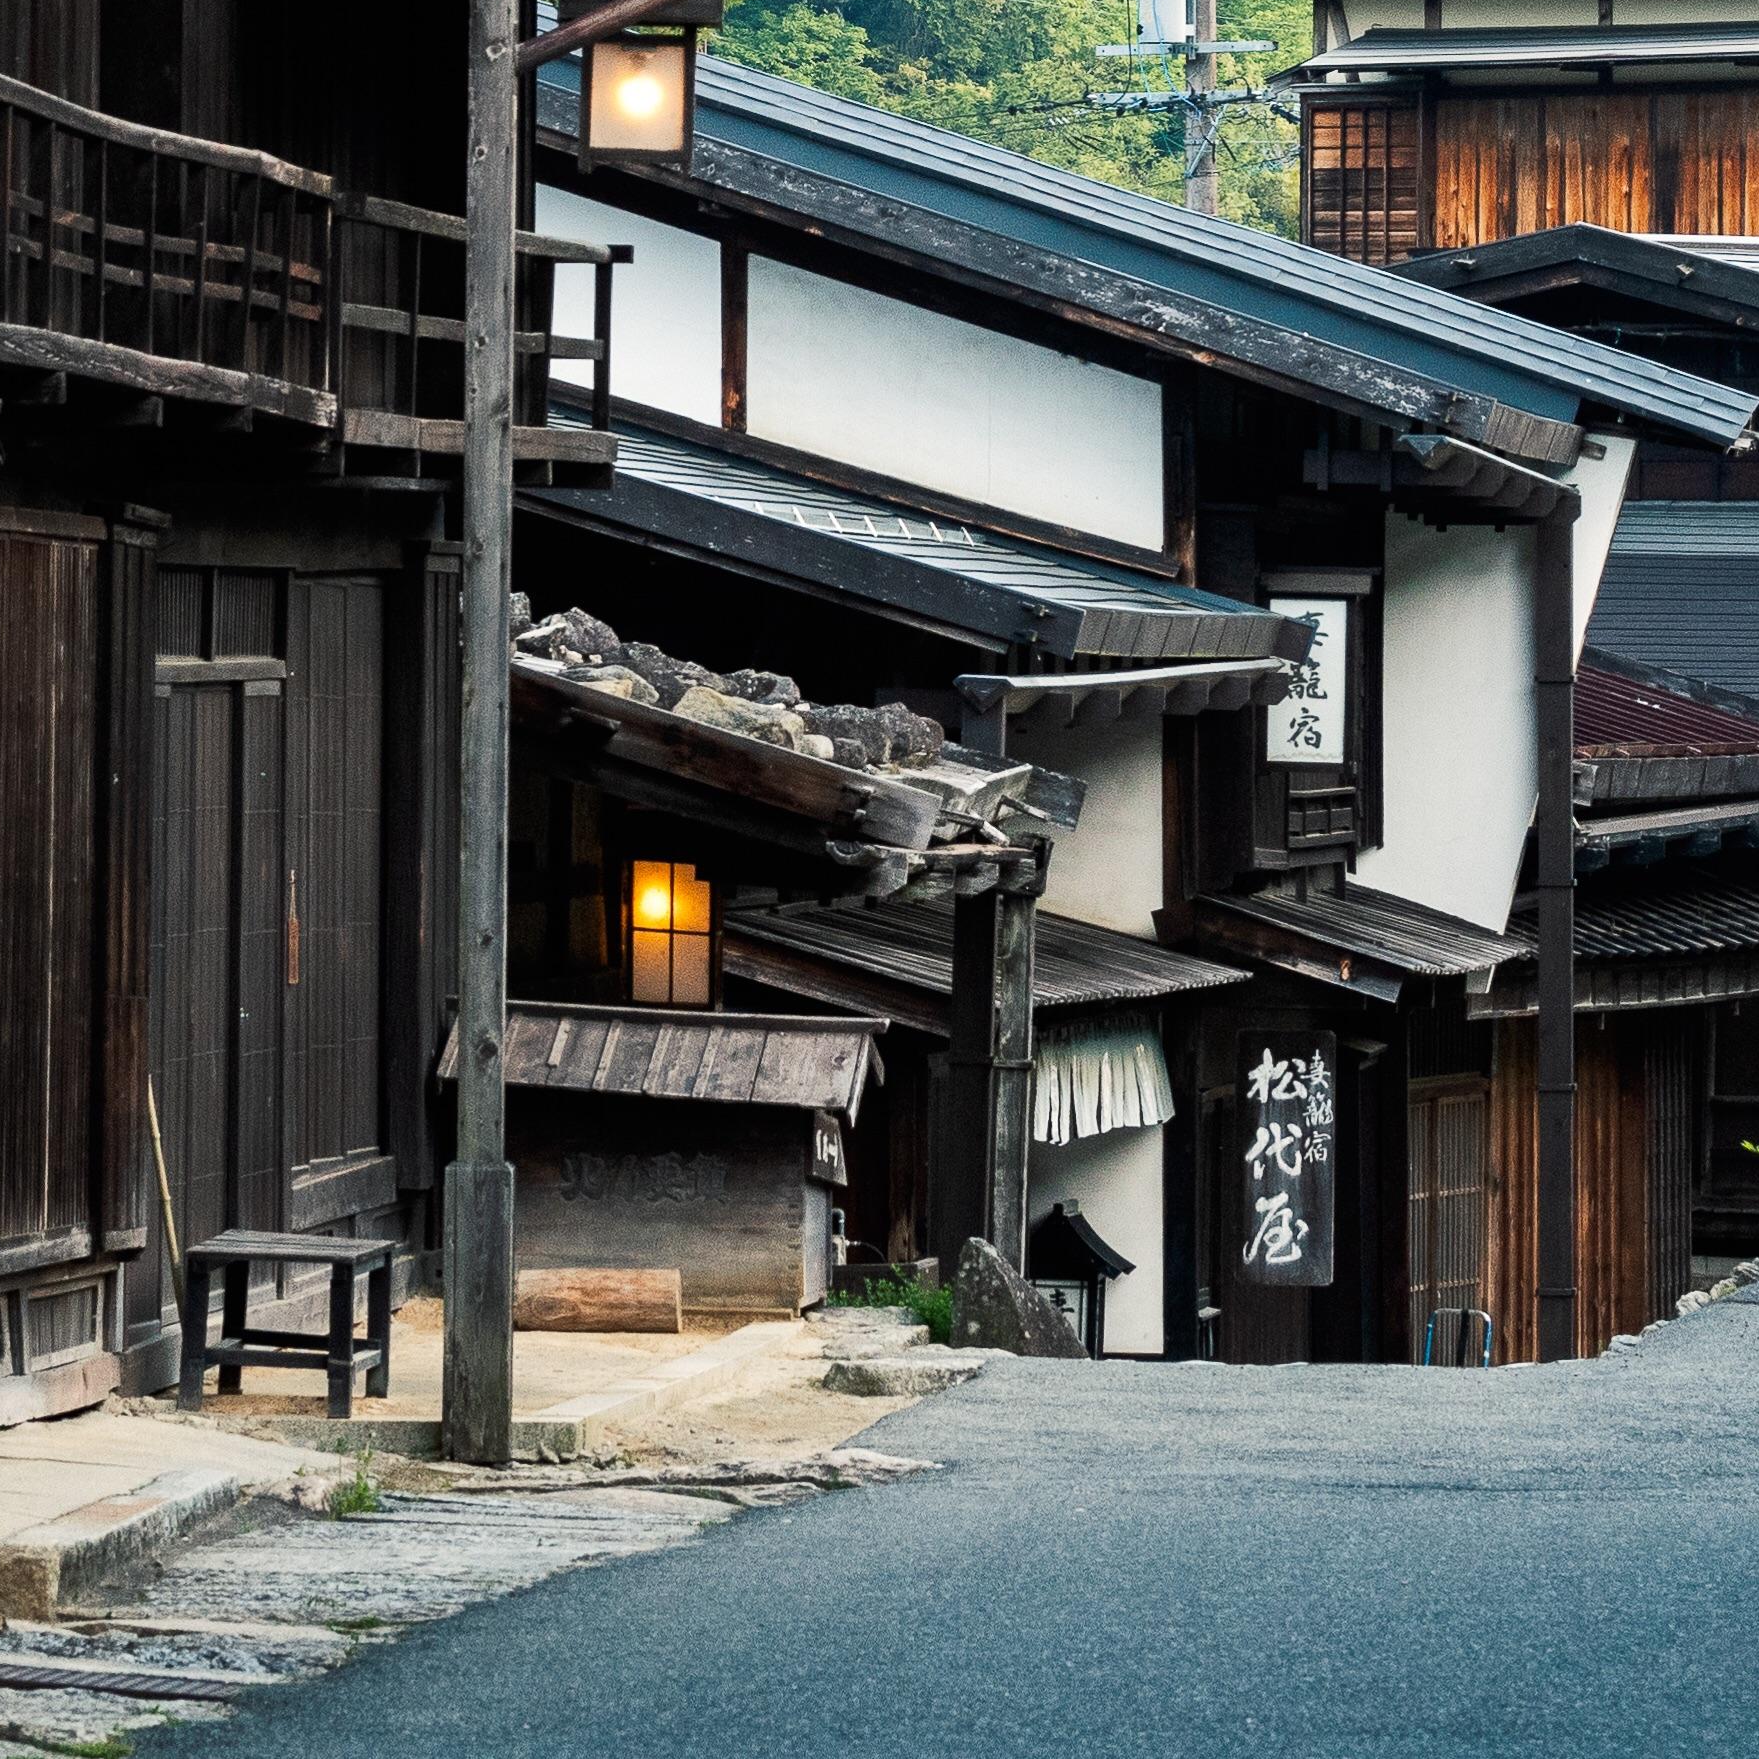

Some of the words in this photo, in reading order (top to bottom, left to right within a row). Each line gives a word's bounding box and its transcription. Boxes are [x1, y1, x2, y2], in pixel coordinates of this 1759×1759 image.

[1243, 1047, 1309, 1264] 松代屋
[1300, 1048, 1334, 1166] 妻籠宿
